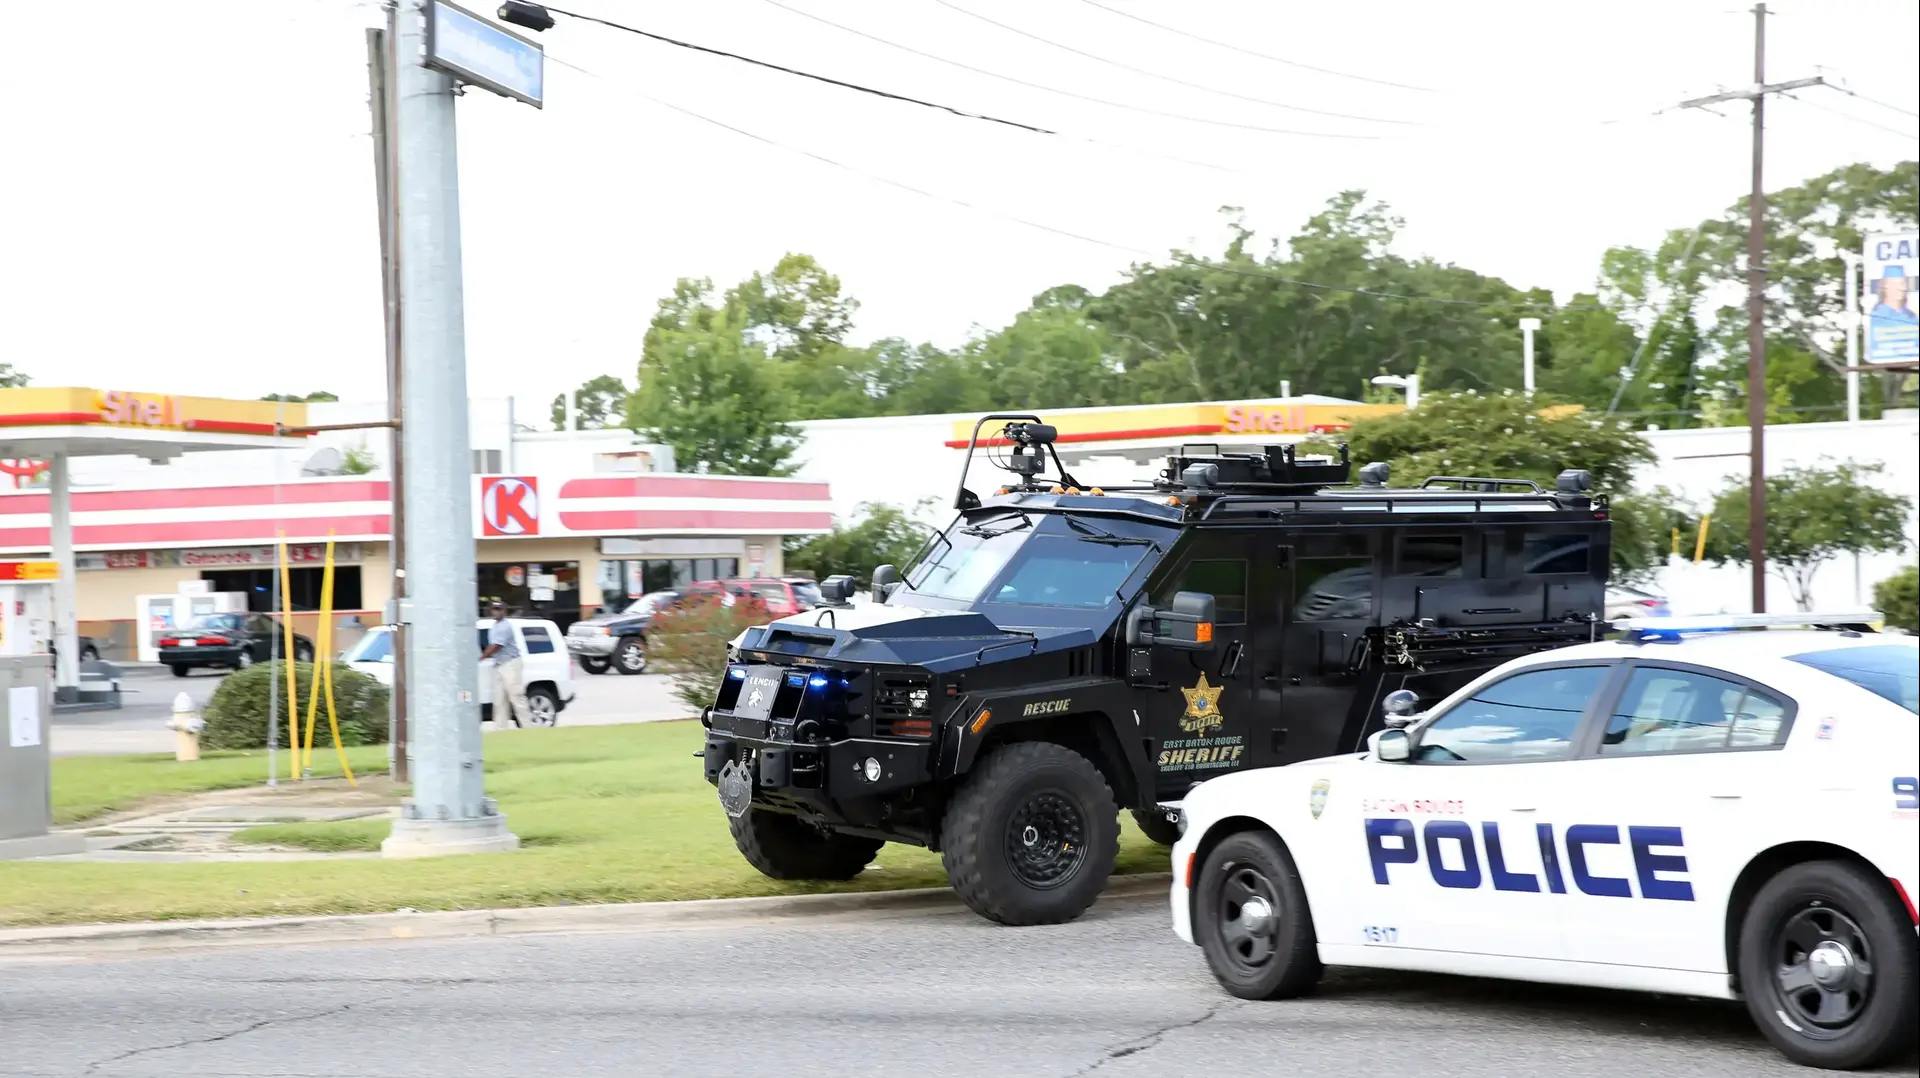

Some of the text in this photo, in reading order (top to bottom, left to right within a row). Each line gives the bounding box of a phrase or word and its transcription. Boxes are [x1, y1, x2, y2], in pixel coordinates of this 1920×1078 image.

[1876, 239, 1919, 261] CA
[103, 391, 182, 425] Shell
[1226, 405, 1304, 432] Shell
[496, 483, 537, 533] K
[1023, 698, 1071, 716] RESCUE
[1163, 736, 1242, 749] EAST BATON ROUGE
[1157, 745, 1244, 766] SHERIFF
[1364, 818, 1697, 902] POLICE
